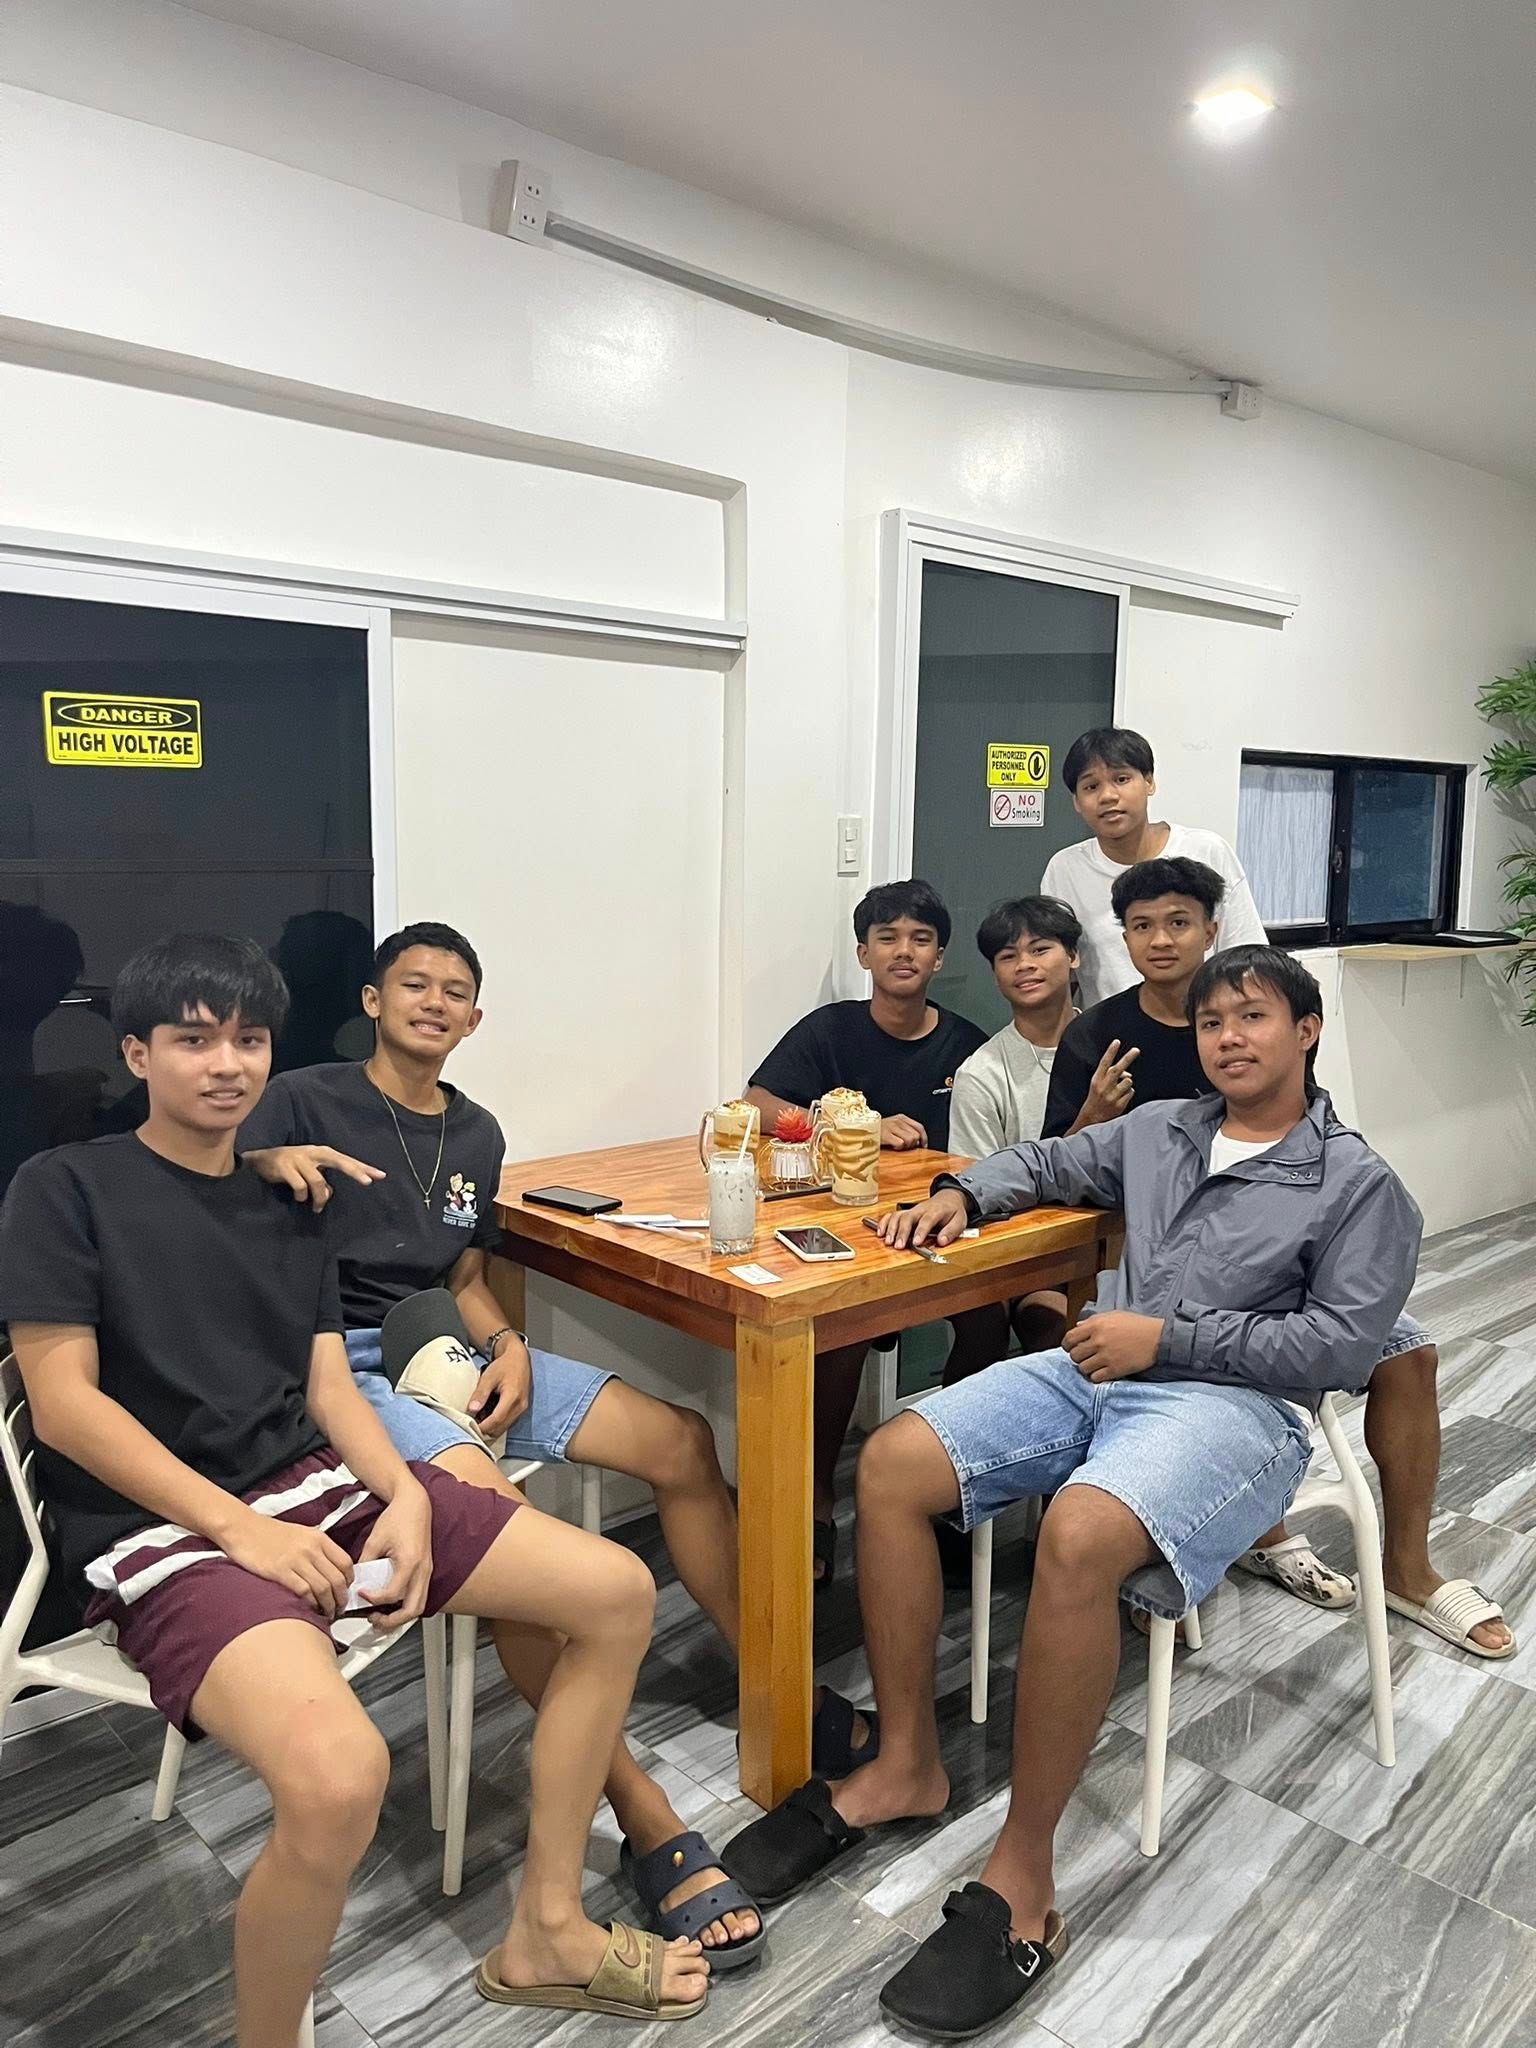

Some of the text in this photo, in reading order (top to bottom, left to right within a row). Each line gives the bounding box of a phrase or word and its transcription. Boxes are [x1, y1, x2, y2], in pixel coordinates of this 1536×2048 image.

[80, 707, 173, 725] DANGER
[58, 731, 194, 755] HIGH VOLTAGE
[991, 750, 1027, 760] AUTHORIZED
[991, 761, 1025, 771] PERSONNEL
[1001, 772, 1017, 781] ONLY
[1018, 795, 1036, 806] NO
[1011, 807, 1041, 821] Smoking
